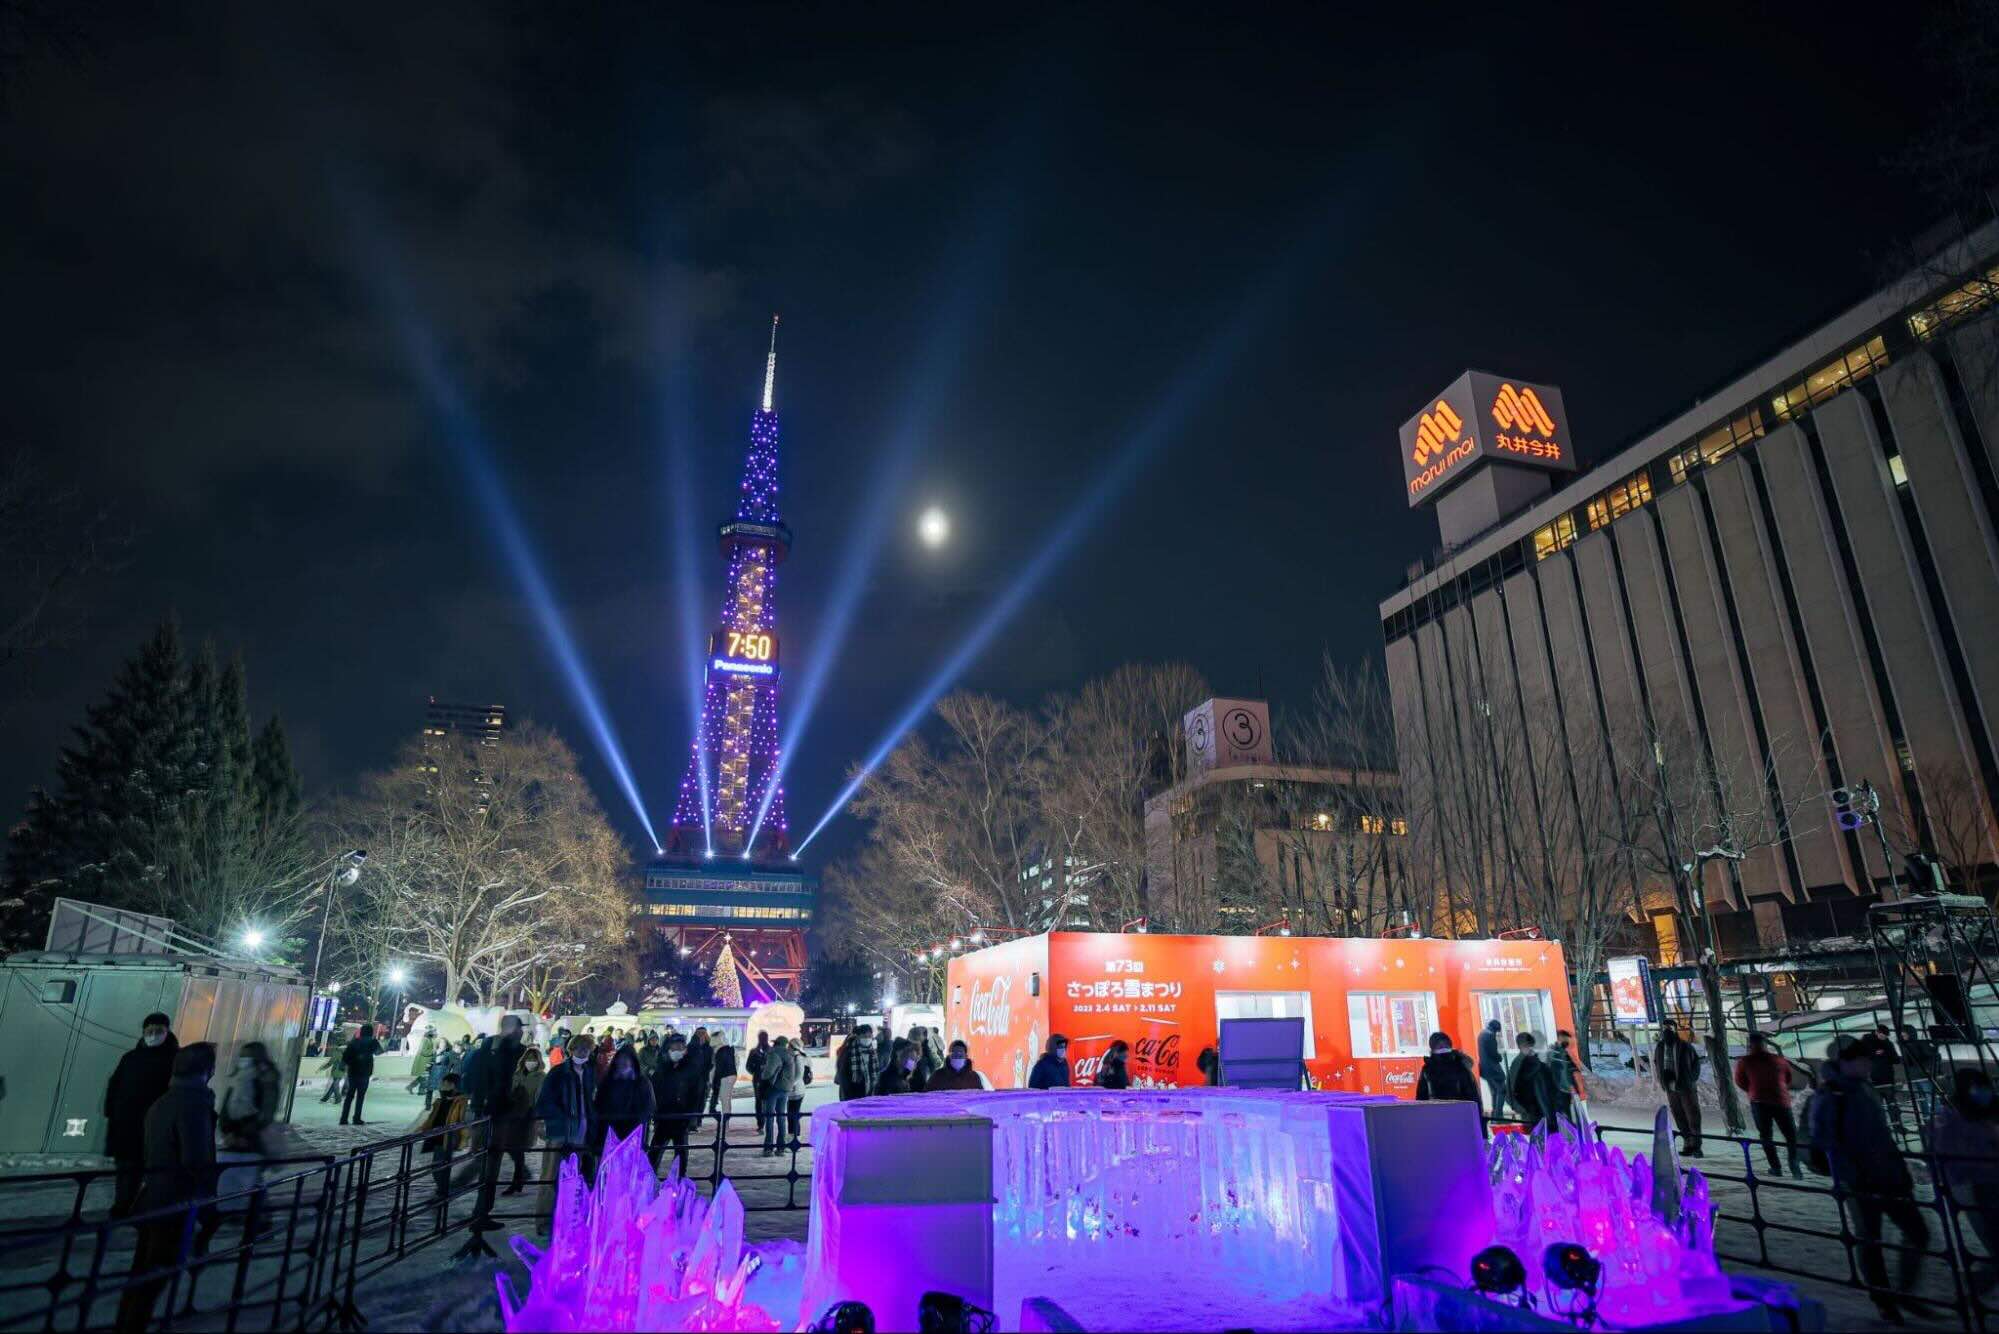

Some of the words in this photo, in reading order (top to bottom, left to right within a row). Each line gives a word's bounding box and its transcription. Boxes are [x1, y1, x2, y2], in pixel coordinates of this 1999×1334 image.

[1496, 433, 1561, 461] 丸井今井
[728, 632, 771, 660] 7:50
[714, 659, 773, 675] Panasonic
[1104, 959, 1144, 973] 第73回
[1066, 979, 1182, 998] さっぽろ雪まつり
[1112, 1003, 1132, 1013] SAT
[1158, 1003, 1177, 1013] SAT
